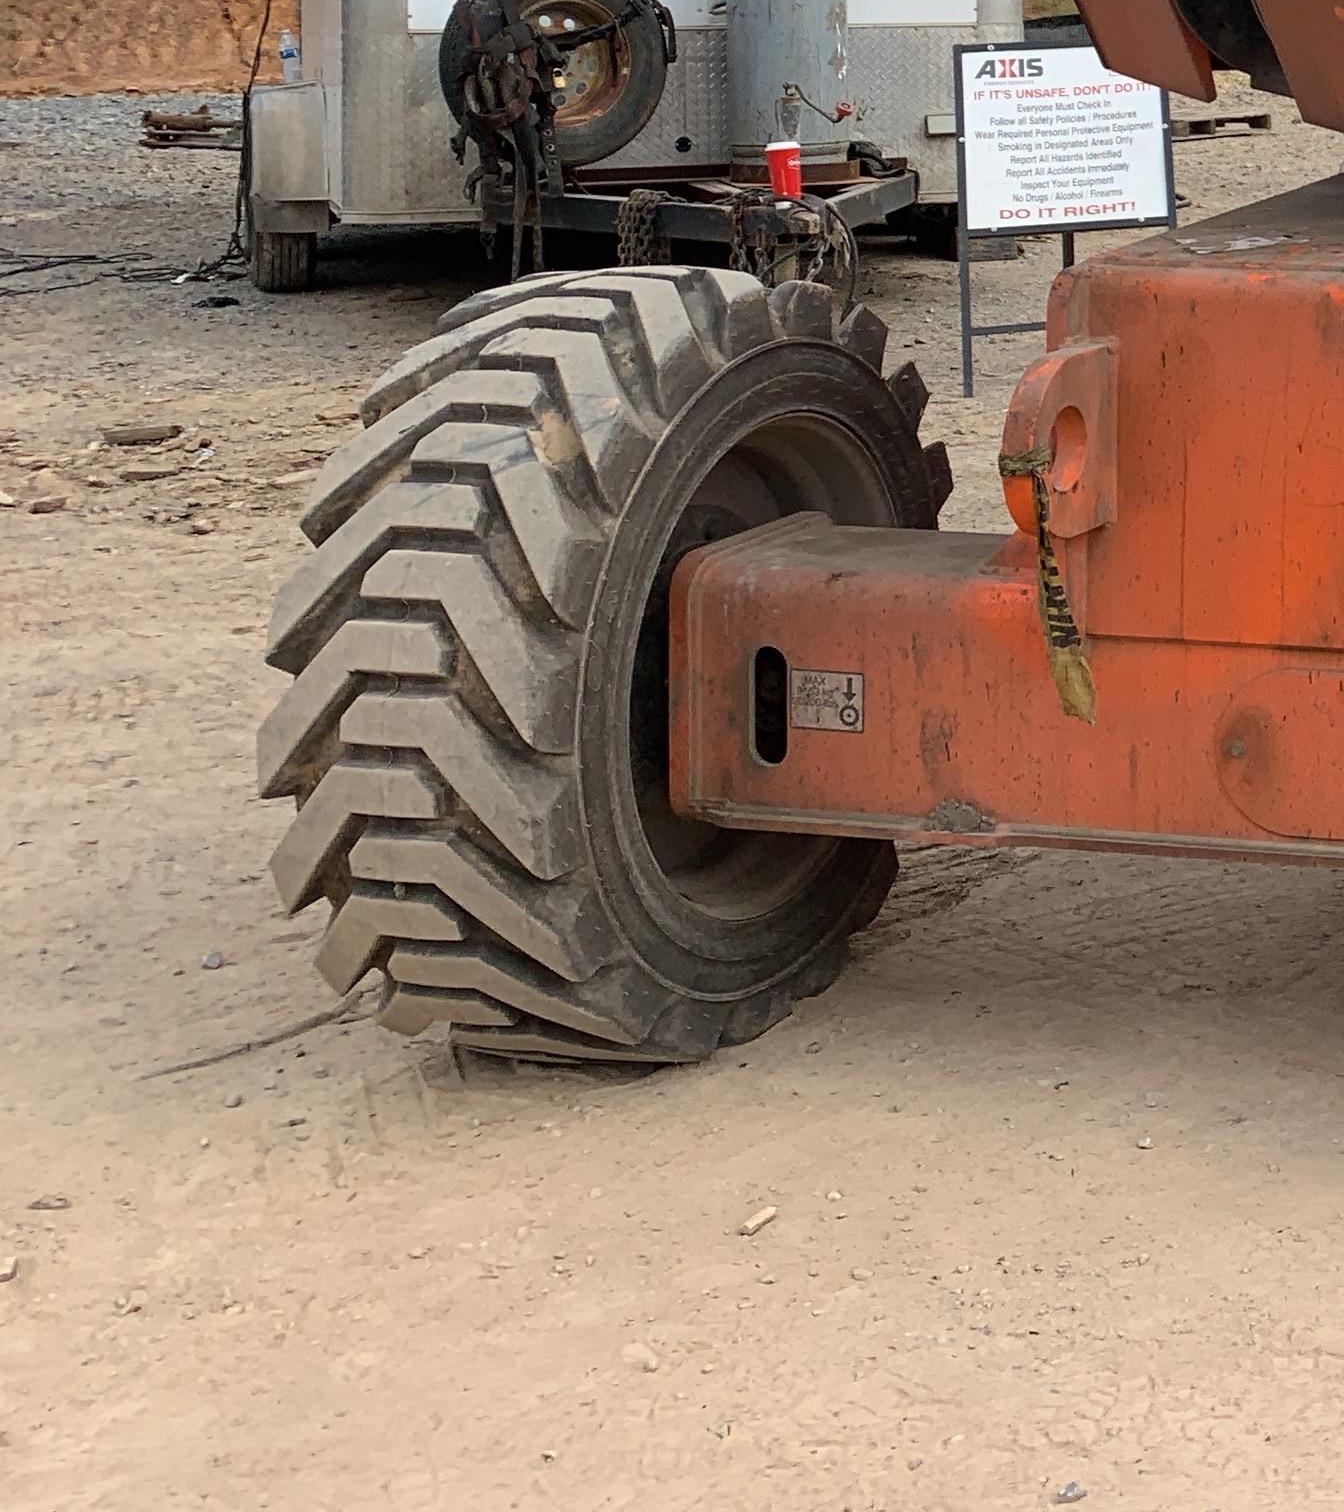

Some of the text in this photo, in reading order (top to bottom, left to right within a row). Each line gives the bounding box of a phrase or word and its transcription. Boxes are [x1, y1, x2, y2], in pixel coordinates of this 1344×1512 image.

[974, 58, 1044, 79] AXIS
[974, 90, 985, 101] IF
[990, 89, 1012, 100] IT'S
[1073, 85, 1111, 96] DON'T
[1115, 83, 1133, 93] DO
[1017, 99, 1111, 114] Everyone Must Check In
[990, 117, 1016, 126] Follow
[1029, 115, 1053, 126] Safety
[1056, 115, 1086, 124] Policies
[1093, 110, 1137, 121] Procedures
[975, 121, 1154, 140] Wear Required Personal Protective Equipment
[998, 136, 1134, 153] Smoking in Designated Areas Only
[1010, 149, 1122, 166] Report All Hazards Identified
[1006, 162, 1130, 179] Report All Accidents Immediately
[1020, 176, 1115, 191] Inspect Your Equipment
[1013, 194, 1024, 202] No
[1026, 193, 1049, 204] Drugs
[1055, 191, 1083, 200] Alcohol
[1090, 188, 1123, 198] Firearms
[999, 201, 1136, 219] DO IT RIGHT!
